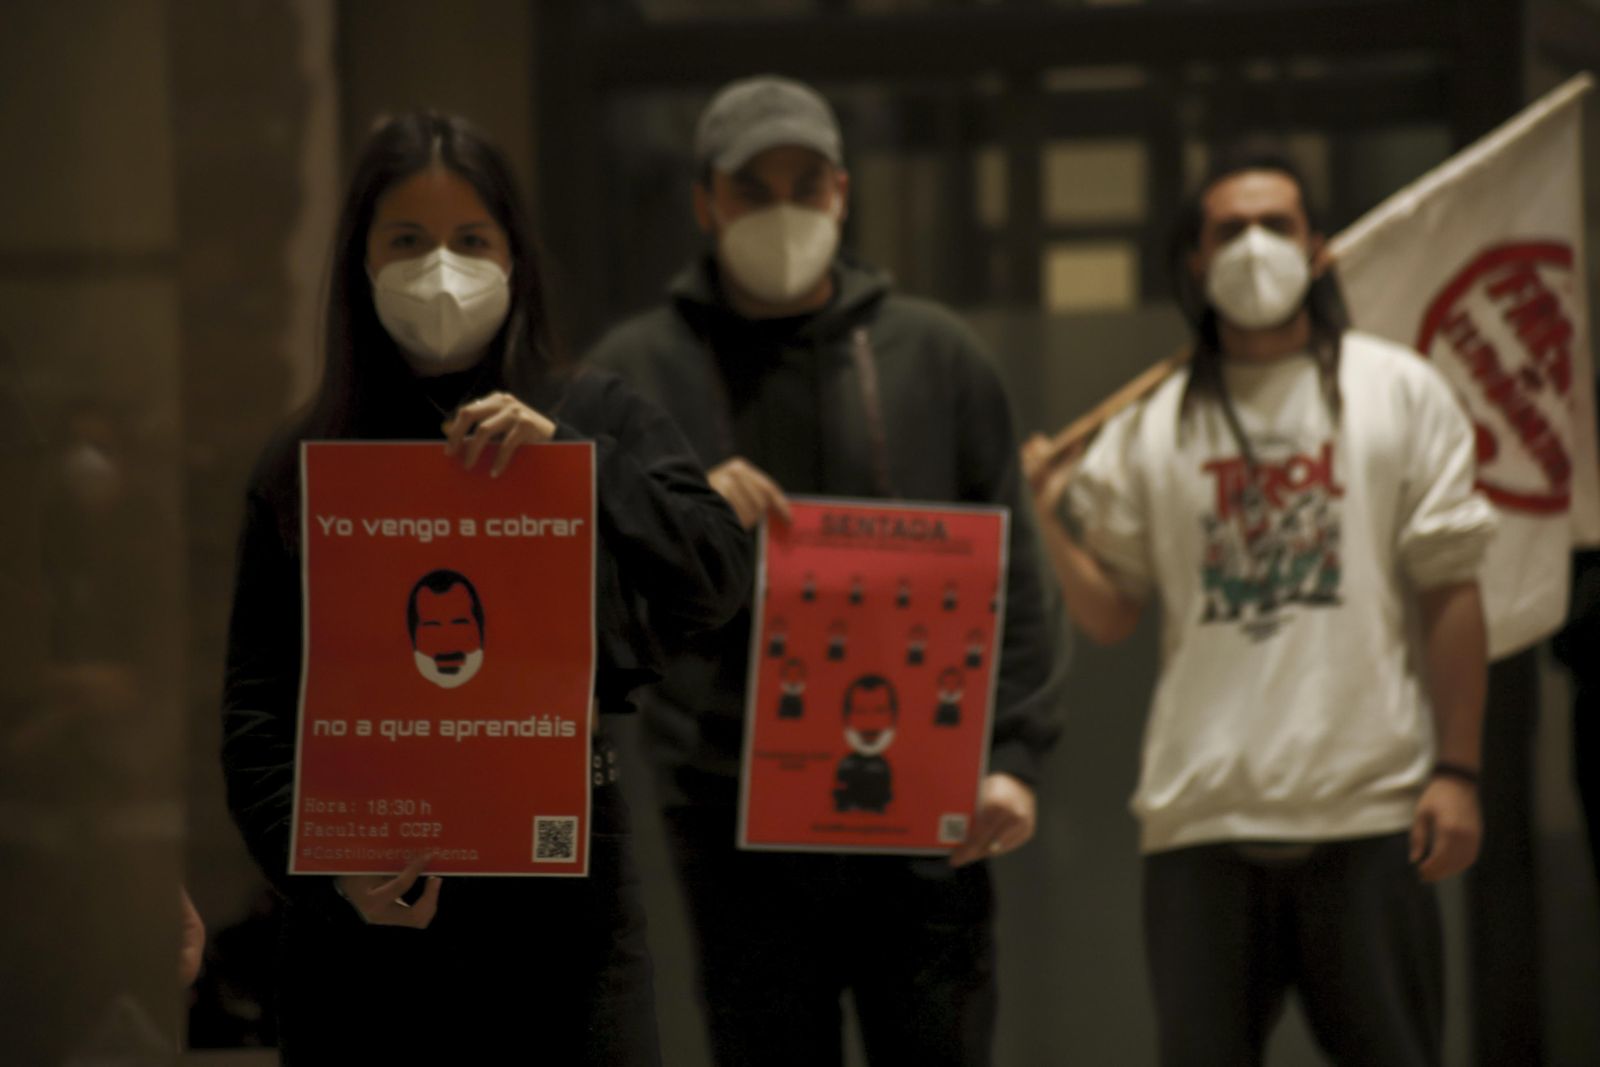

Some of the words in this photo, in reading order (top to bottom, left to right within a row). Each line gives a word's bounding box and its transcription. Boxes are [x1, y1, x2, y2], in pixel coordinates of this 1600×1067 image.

[316, 515, 354, 537] Yo
[362, 517, 450, 543] vengo
[459, 517, 477, 537] a
[484, 514, 585, 537] cobrar
[313, 718, 347, 737] no
[355, 718, 372, 737] a
[379, 718, 431, 742] que
[439, 713, 577, 742] aprendáis
[303, 798, 357, 814] Hora:
[367, 799, 415, 815] 18:30
[420, 800, 432, 815] h
[302, 821, 389, 838] Facultad
[399, 822, 443, 838] CCPP
